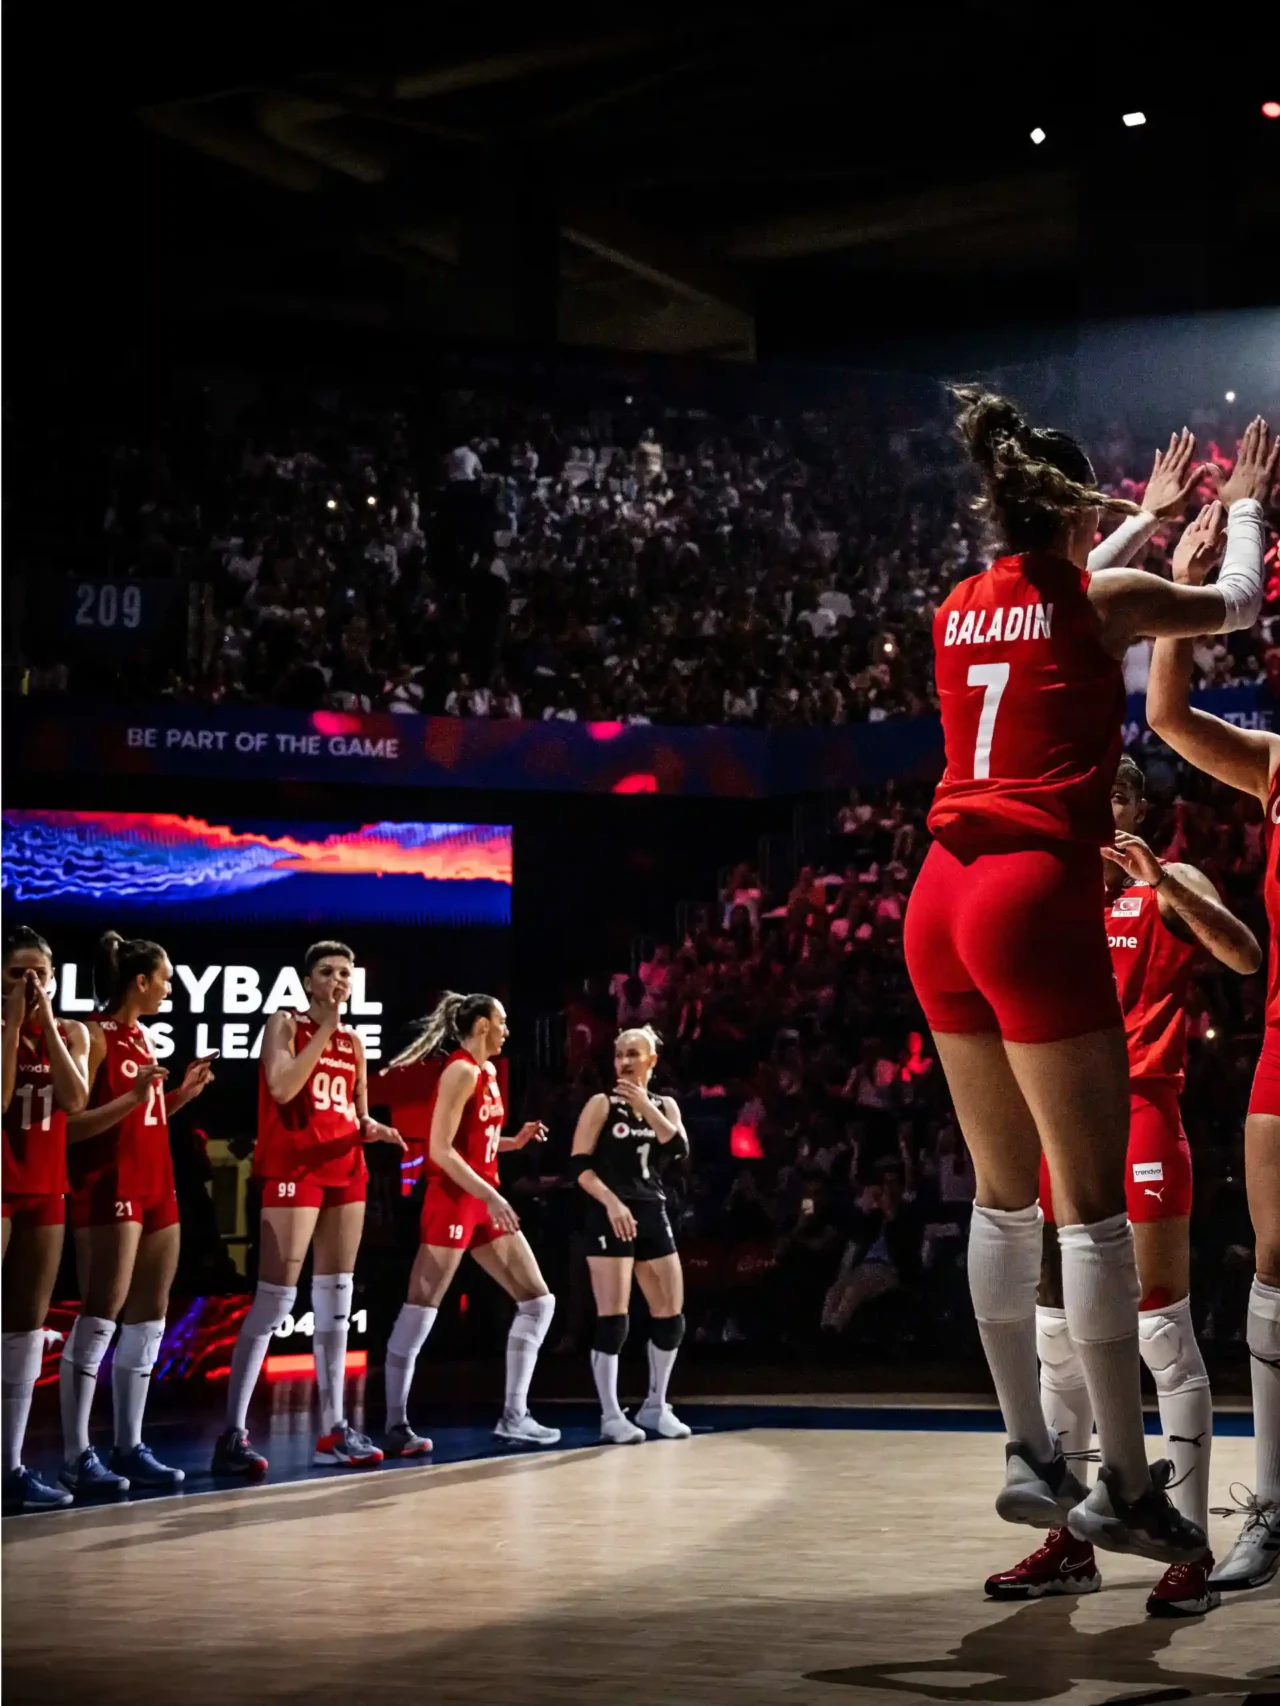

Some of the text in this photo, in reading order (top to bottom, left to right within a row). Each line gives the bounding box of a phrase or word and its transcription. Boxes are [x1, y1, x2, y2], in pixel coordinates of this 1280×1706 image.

[74, 583, 143, 629] 209
[943, 602, 1055, 647] BALADIN
[126, 726, 401, 759] BE PART OF THE GAME
[966, 662, 1011, 780] 7
[15, 1082, 54, 1132] 11
[143, 1079, 168, 1127] 21
[312, 1071, 349, 1114] 99
[636, 1142, 651, 1180] 1
[114, 1200, 133, 1218] 21
[278, 1181, 296, 1198] 99
[448, 1223, 464, 1240] 19
